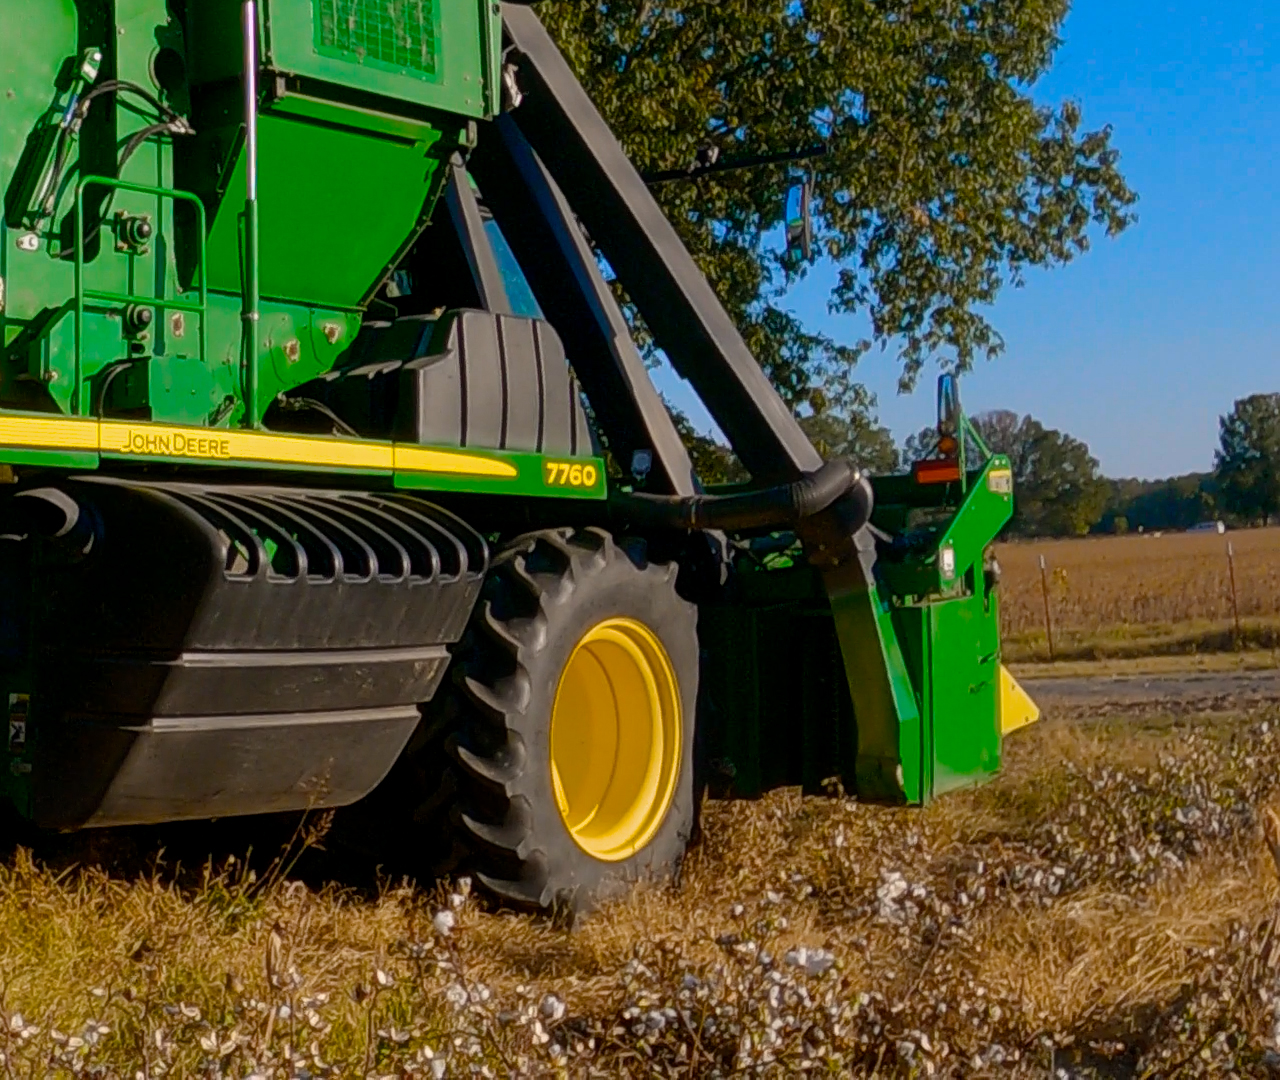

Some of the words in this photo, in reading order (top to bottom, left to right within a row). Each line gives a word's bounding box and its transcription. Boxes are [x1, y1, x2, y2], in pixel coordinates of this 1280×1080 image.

[122, 429, 170, 452] JOHN
[172, 432, 230, 455] DEERE
[546, 462, 596, 486] 7760
